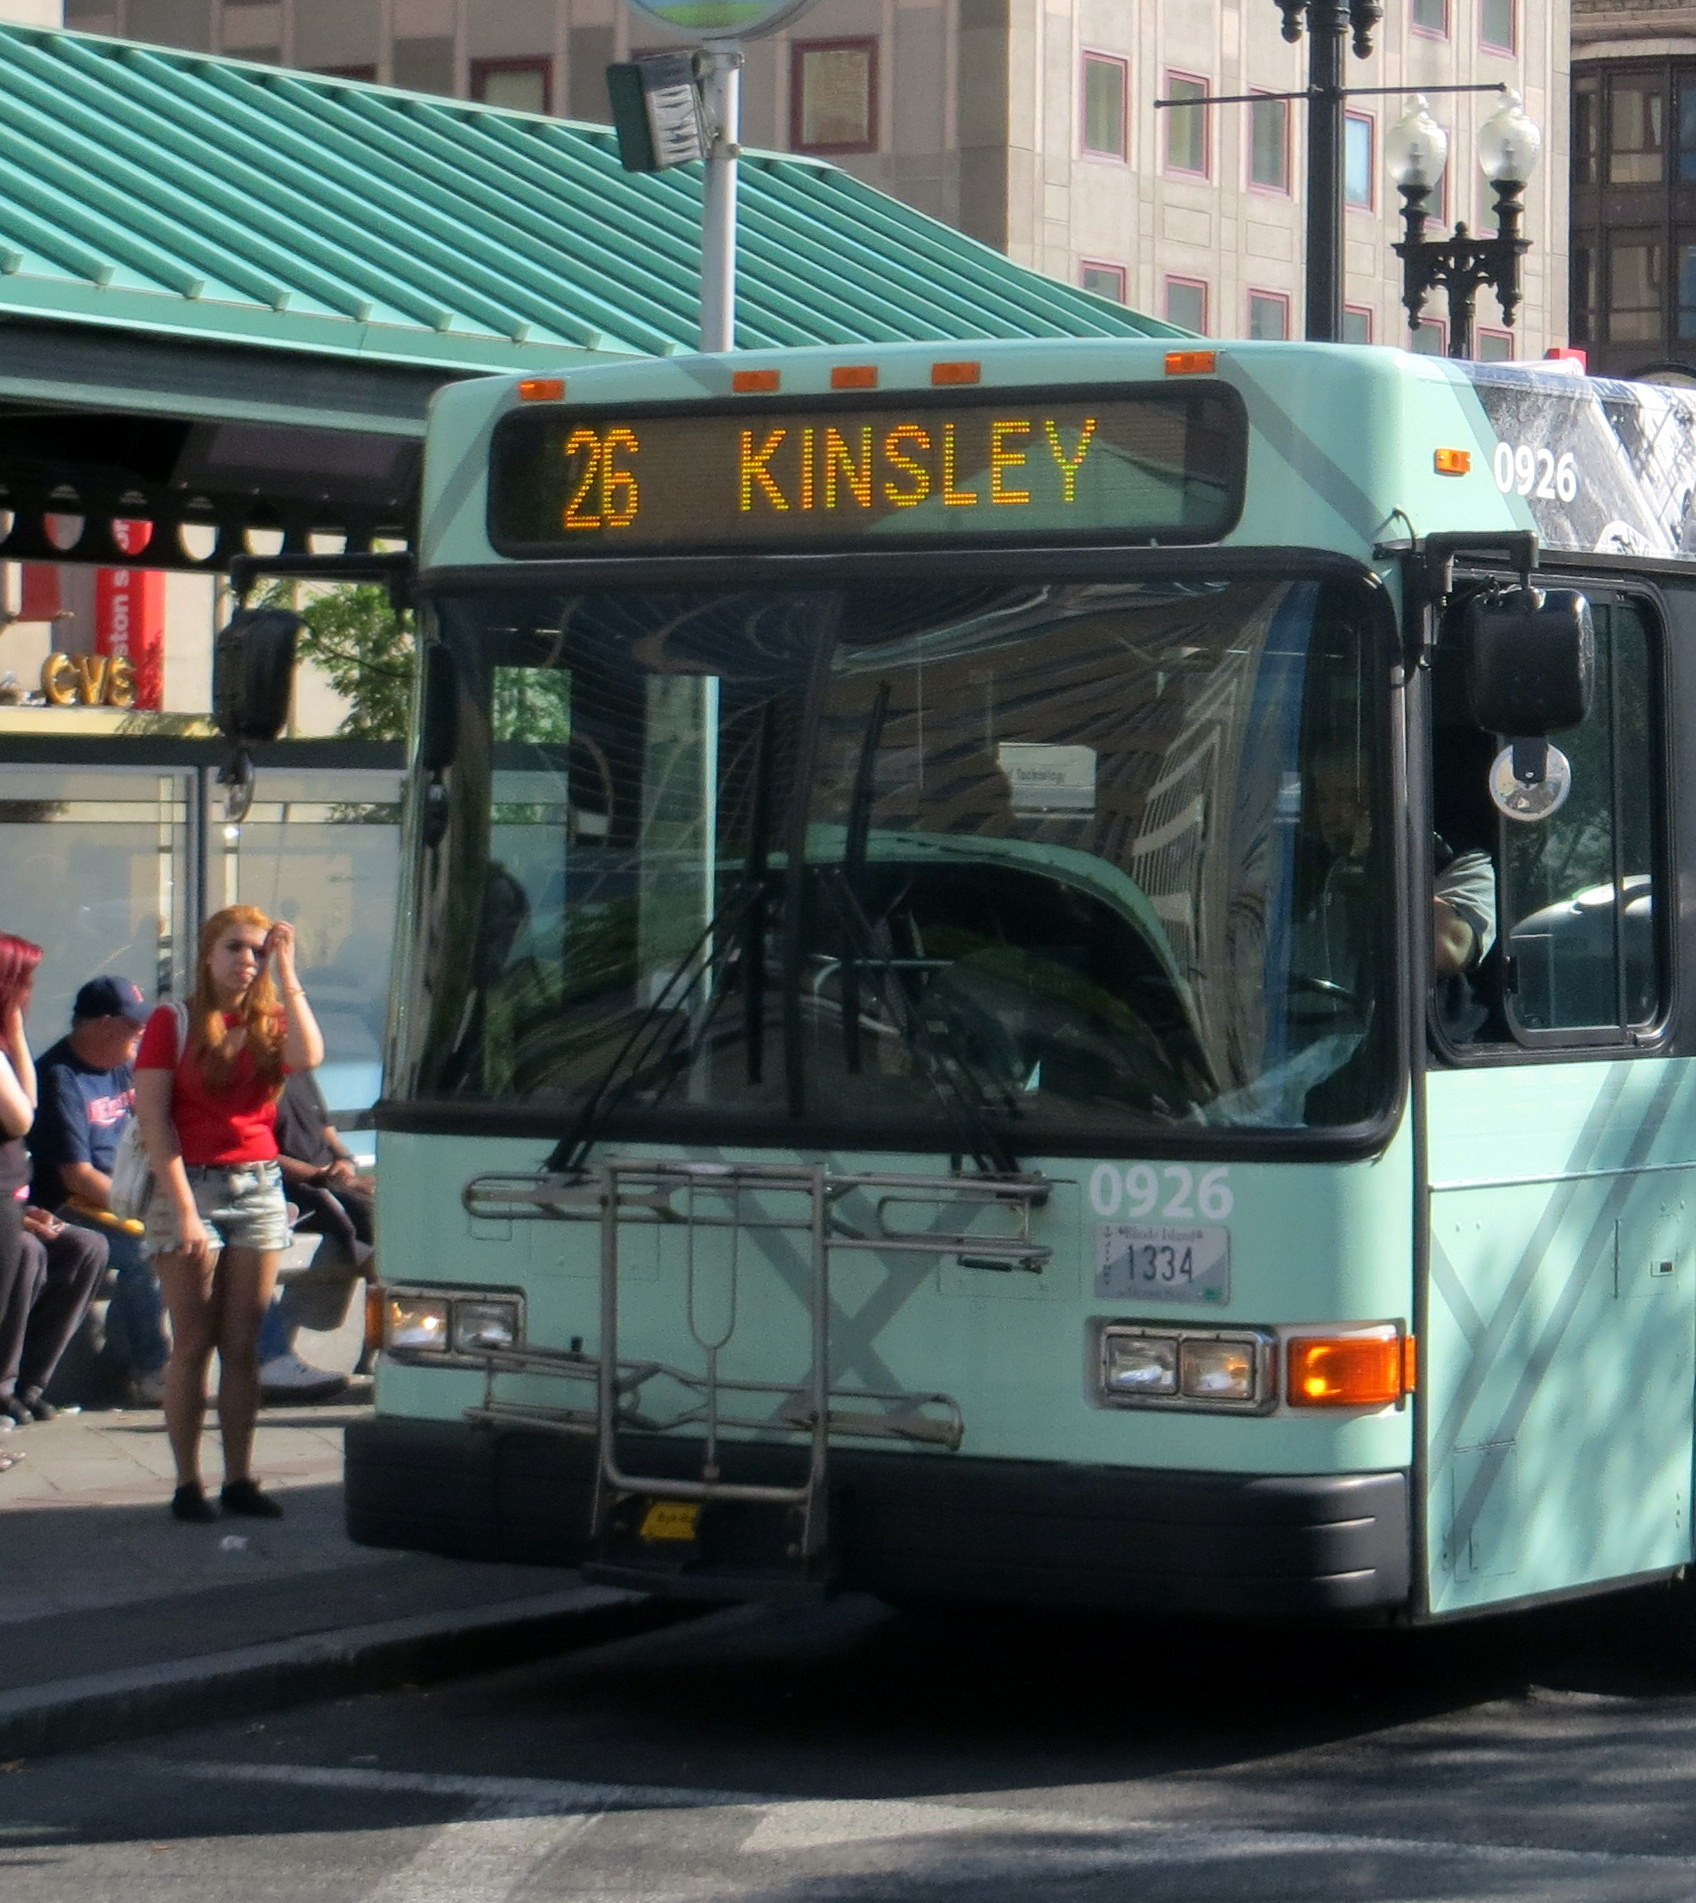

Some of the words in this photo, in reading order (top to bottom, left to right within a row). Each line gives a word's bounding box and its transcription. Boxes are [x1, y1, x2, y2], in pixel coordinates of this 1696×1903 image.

[566, 428, 639, 528] 26
[740, 418, 1097, 511] KINSLEY
[1494, 441, 1578, 502] 0926
[1090, 1163, 1235, 1220] 0926
[1128, 1243, 1193, 1284] 1334
